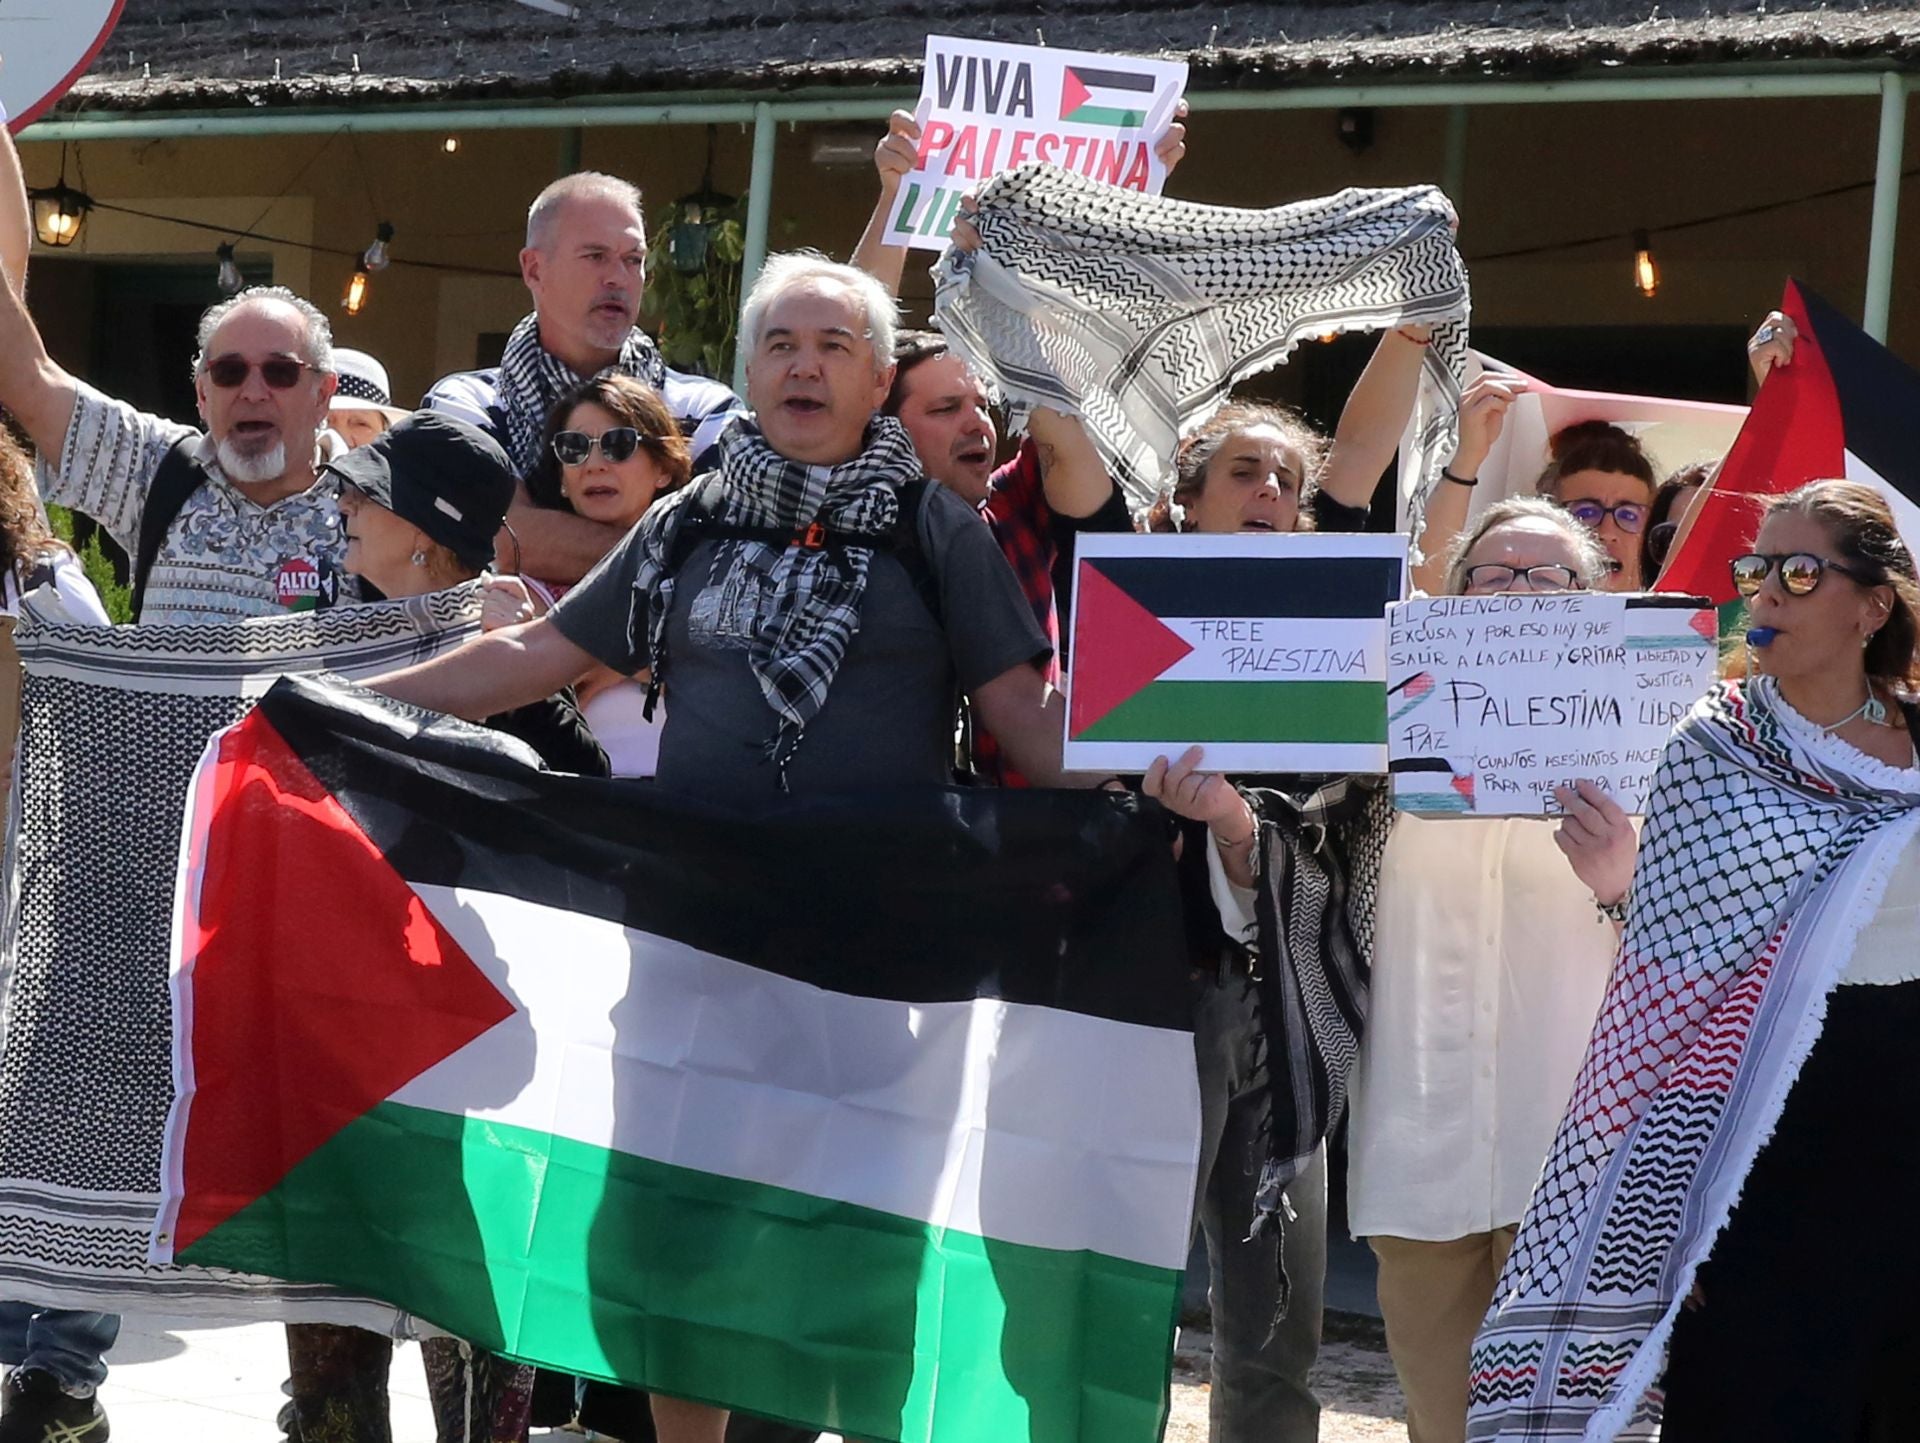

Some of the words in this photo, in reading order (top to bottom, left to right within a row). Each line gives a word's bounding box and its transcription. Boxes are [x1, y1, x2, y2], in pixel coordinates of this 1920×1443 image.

[936, 53, 1033, 118] VIVA
[280, 571, 320, 590] ALTO
[1390, 606, 1419, 628] EL
[1422, 597, 1523, 627] SILENCIO
[1531, 598, 1556, 613] NO
[1562, 598, 1583, 613] TE
[1190, 620, 1264, 641] FREE
[1390, 627, 1457, 646] EXCUSA
[1519, 622, 1549, 637] ESO
[1553, 622, 1577, 640] HAY
[1222, 647, 1367, 674] PALESTINA
[1457, 655, 1468, 669] A
[1441, 678, 1622, 728] PALESTINA
[1403, 723, 1449, 752] PAZ
[1483, 772, 1521, 793] PARA
